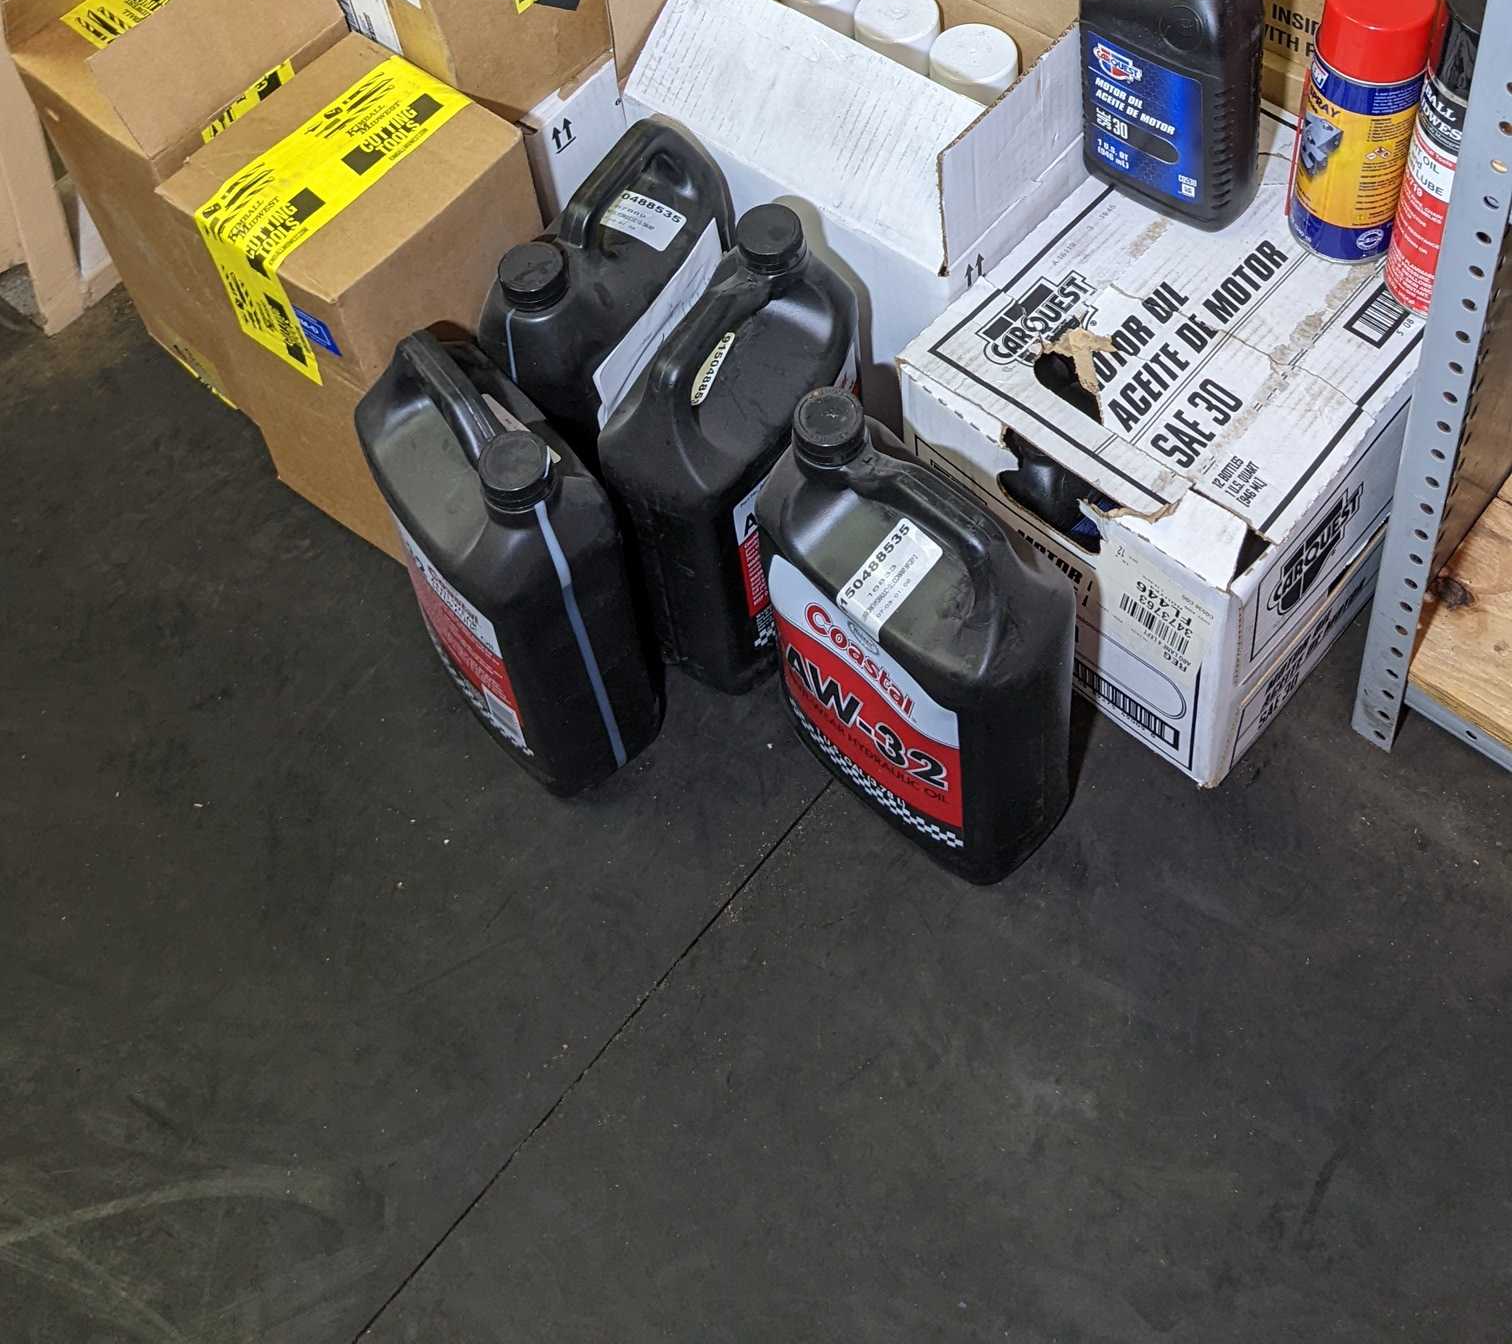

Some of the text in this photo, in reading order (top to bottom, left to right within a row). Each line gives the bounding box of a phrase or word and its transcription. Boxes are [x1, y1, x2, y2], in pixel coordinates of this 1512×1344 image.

[1272, 3, 1321, 36] INSI
[1094, 77, 1144, 110] MOTOR OIL
[1095, 89, 1176, 136] ACEITE DE MOTOR
[1424, 80, 1457, 122] BALL
[346, 104, 387, 138] KIMBALL
[359, 106, 419, 153] CUTTING
[360, 100, 401, 136] MIDWEST
[375, 119, 421, 155] TOOLS
[1112, 115, 1129, 141] 30
[1421, 102, 1463, 142] DWES
[1415, 169, 1445, 197] LUBE
[1422, 155, 1440, 174] OIL
[227, 199, 265, 243] KIMBALL
[240, 196, 280, 240] MIDWEST
[246, 203, 299, 260] CUTTING
[256, 216, 300, 257] TOOLS
[991, 273, 1098, 359] CARQUEST
[1091, 281, 1190, 392] OTOR OIL
[1107, 239, 1290, 434] ACEITE DE MOTOR
[1150, 378, 1243, 469] SAE 30
[1211, 455, 1244, 489] 12 BOTTLES
[1236, 460, 1260, 484] QUART
[1272, 482, 1364, 604] CARQUEST
[1136, 580, 1192, 627] FL446
[1138, 594, 1193, 639] 3473763
[803, 600, 916, 719] Coastal
[1162, 651, 1188, 673] REG
[785, 643, 950, 792] AW-32
[922, 786, 952, 804] OIL
